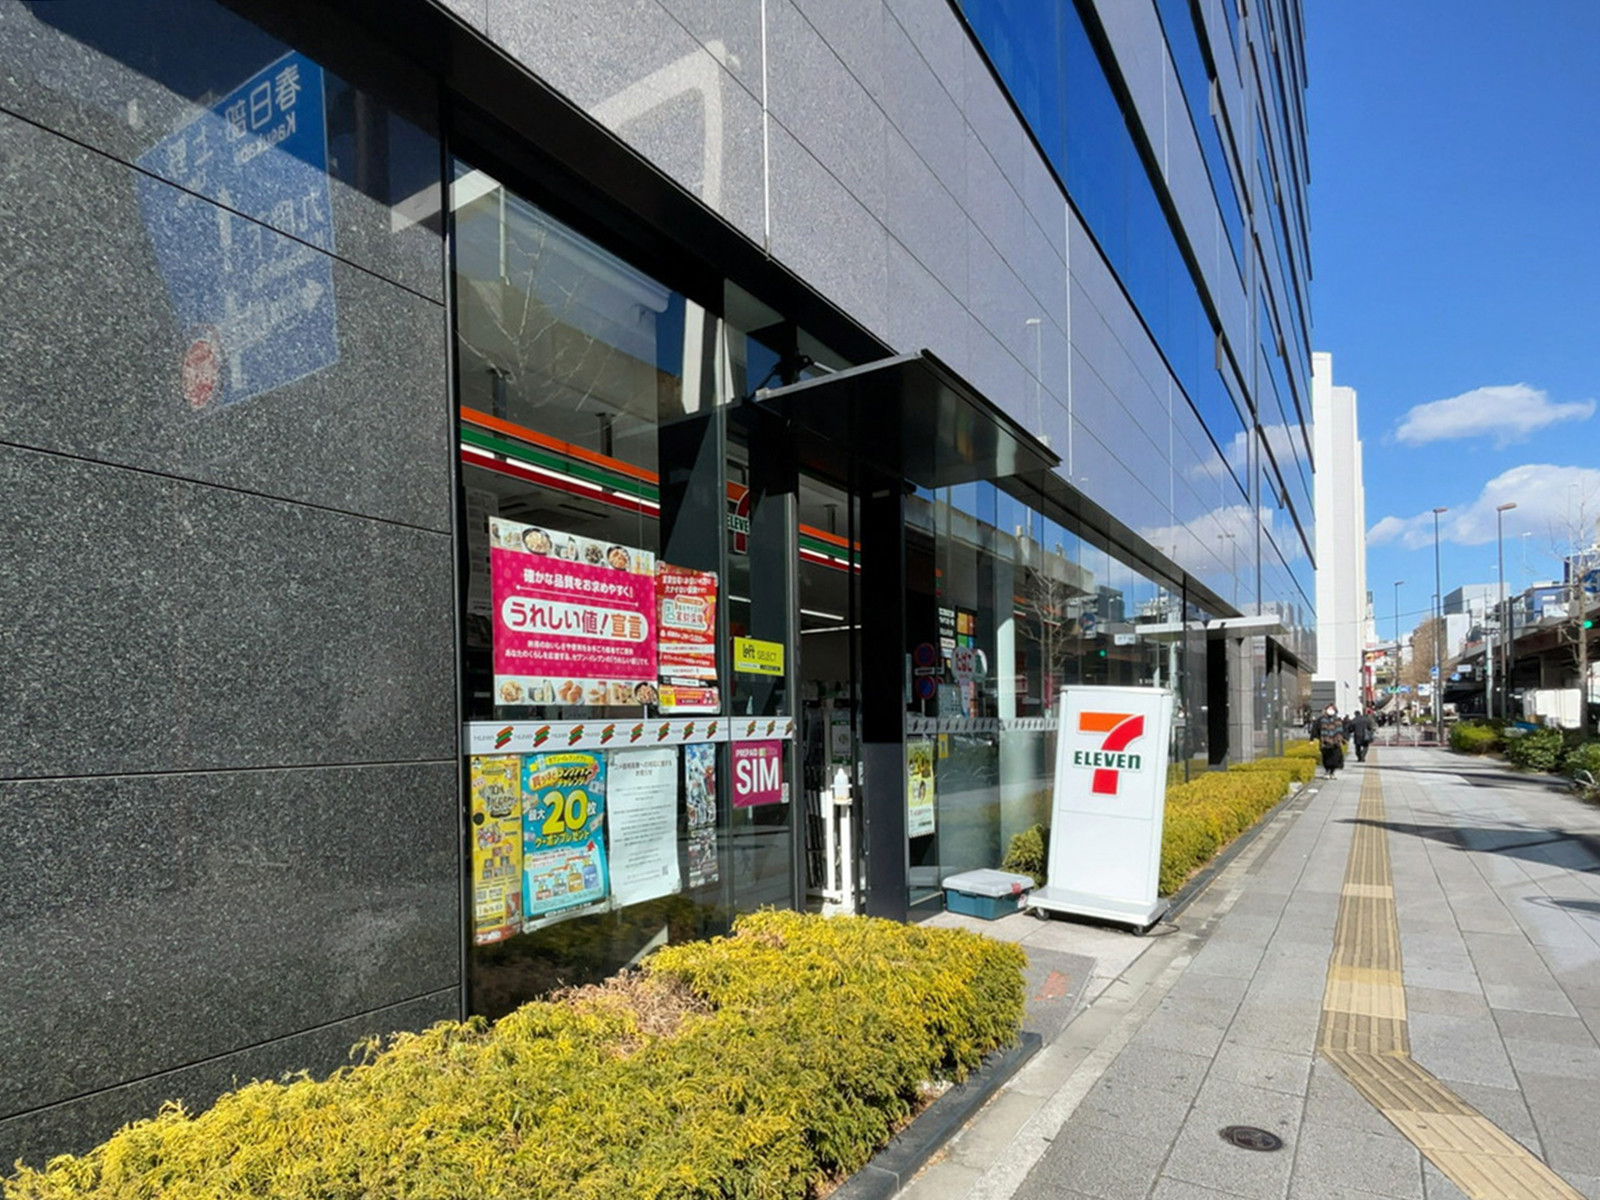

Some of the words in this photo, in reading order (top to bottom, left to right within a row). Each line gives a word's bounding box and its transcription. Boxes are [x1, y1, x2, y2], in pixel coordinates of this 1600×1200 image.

[727, 514, 750, 534] ELEVE
[510, 601, 642, 639] うれしい値!宣言
[1079, 711, 1145, 795] 7
[736, 756, 779, 795] SIM
